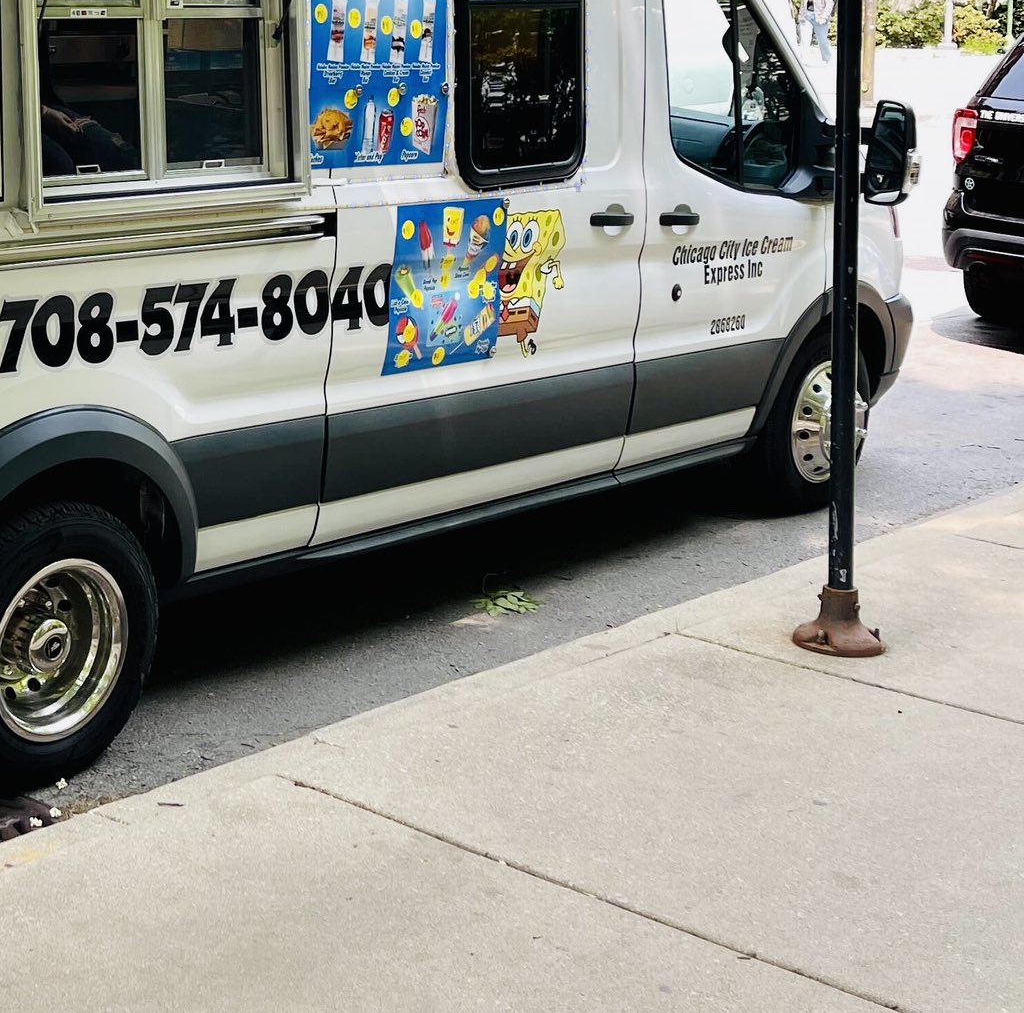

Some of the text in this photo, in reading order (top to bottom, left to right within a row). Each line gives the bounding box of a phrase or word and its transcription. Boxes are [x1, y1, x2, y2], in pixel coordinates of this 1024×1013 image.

[672, 235, 794, 266] Chicago City Ice Cream
[704, 259, 763, 285] Express Inc
